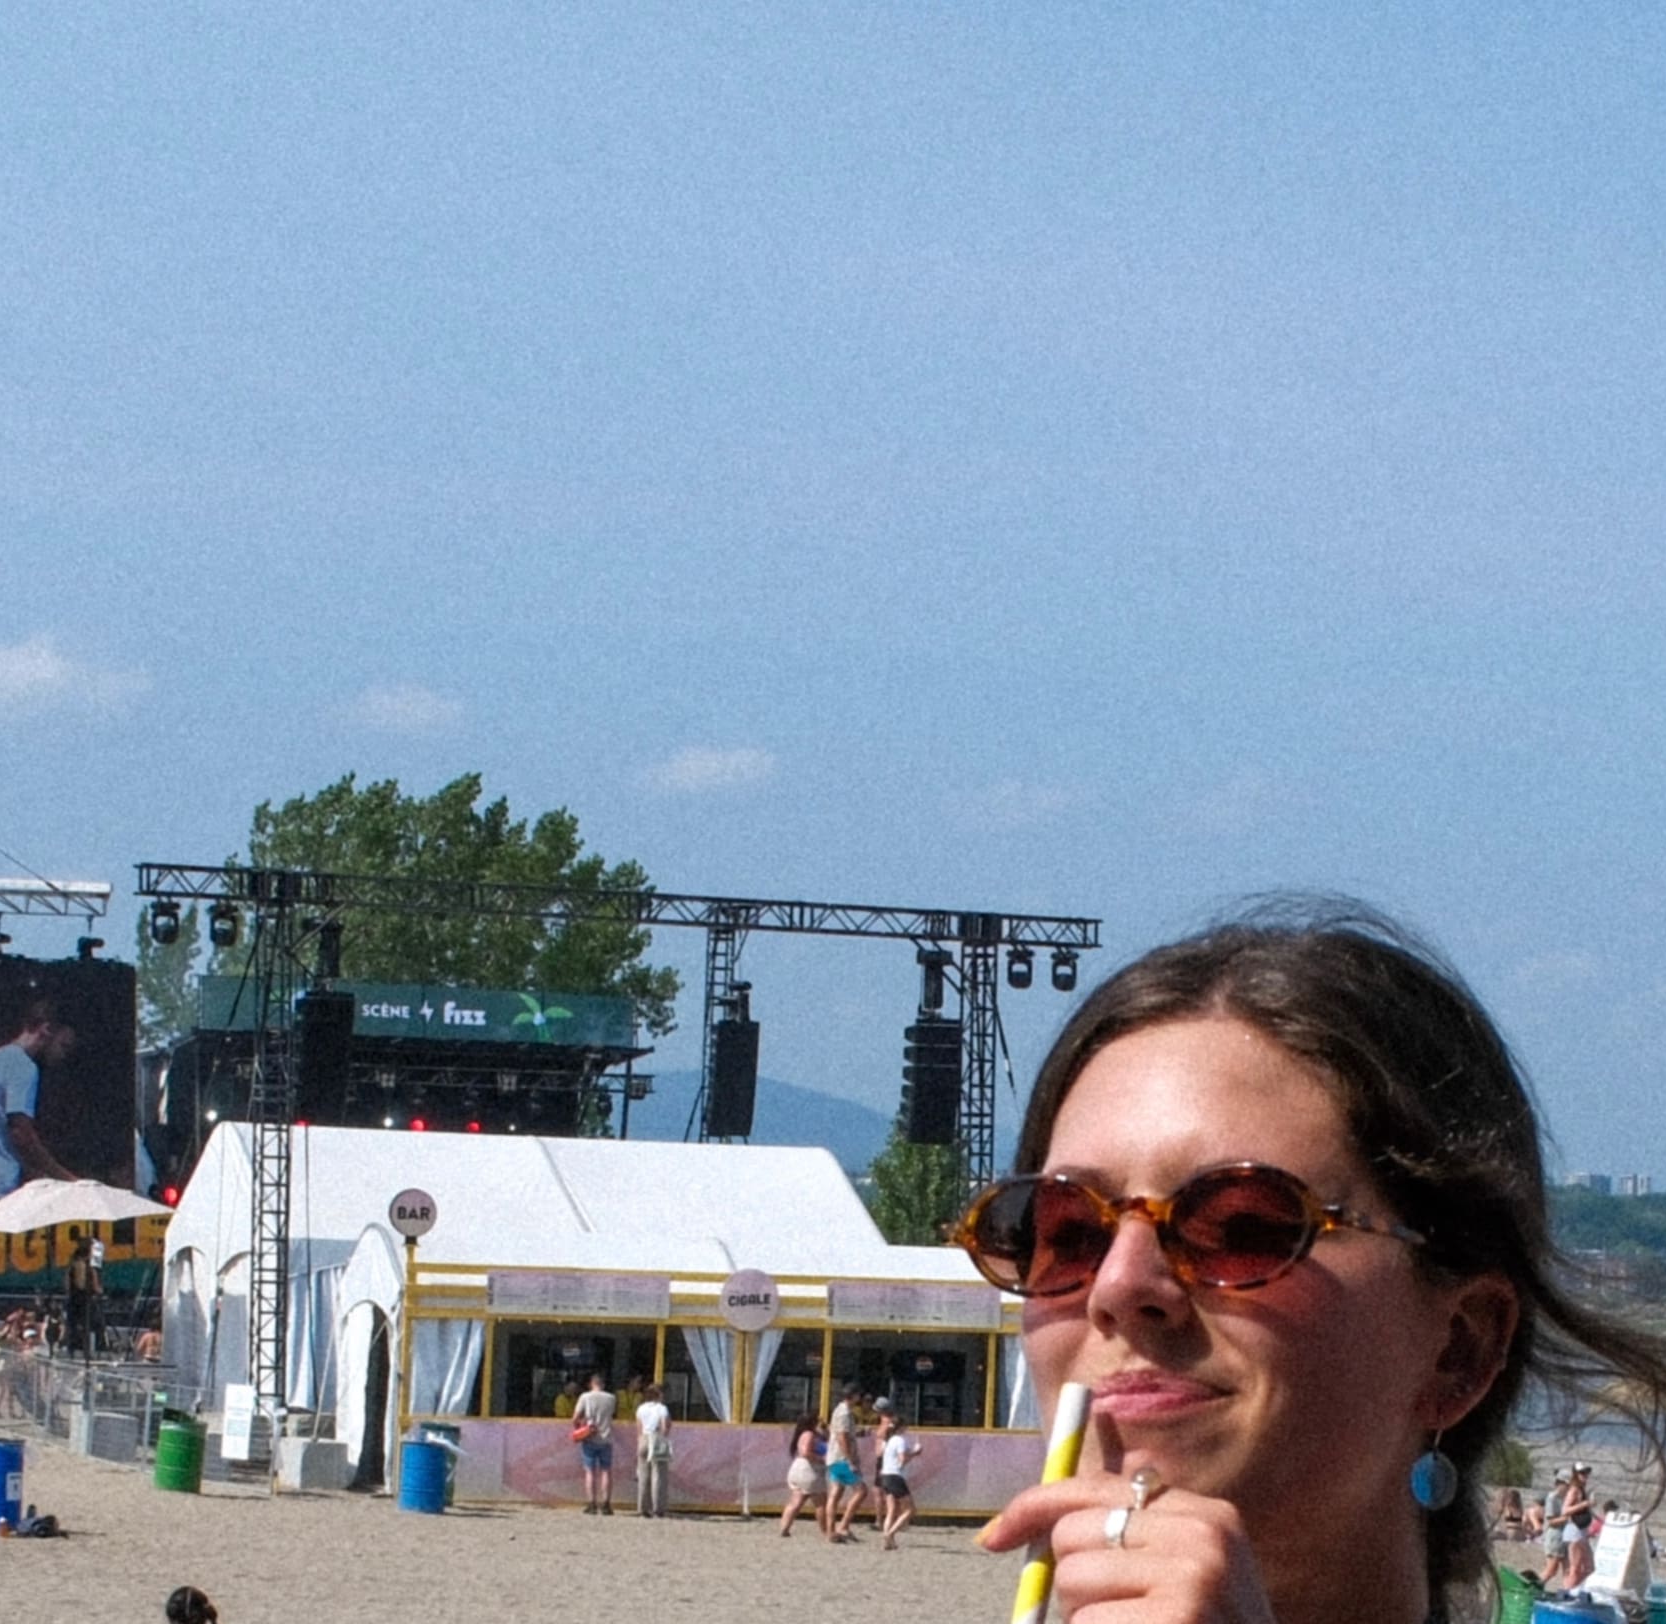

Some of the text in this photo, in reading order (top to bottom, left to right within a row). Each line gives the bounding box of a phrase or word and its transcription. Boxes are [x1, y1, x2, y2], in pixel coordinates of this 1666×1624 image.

[361, 1001, 486, 1025] SCÈNE fizz
[397, 1206, 430, 1220] BAR
[728, 1293, 771, 1307] CIGALE
